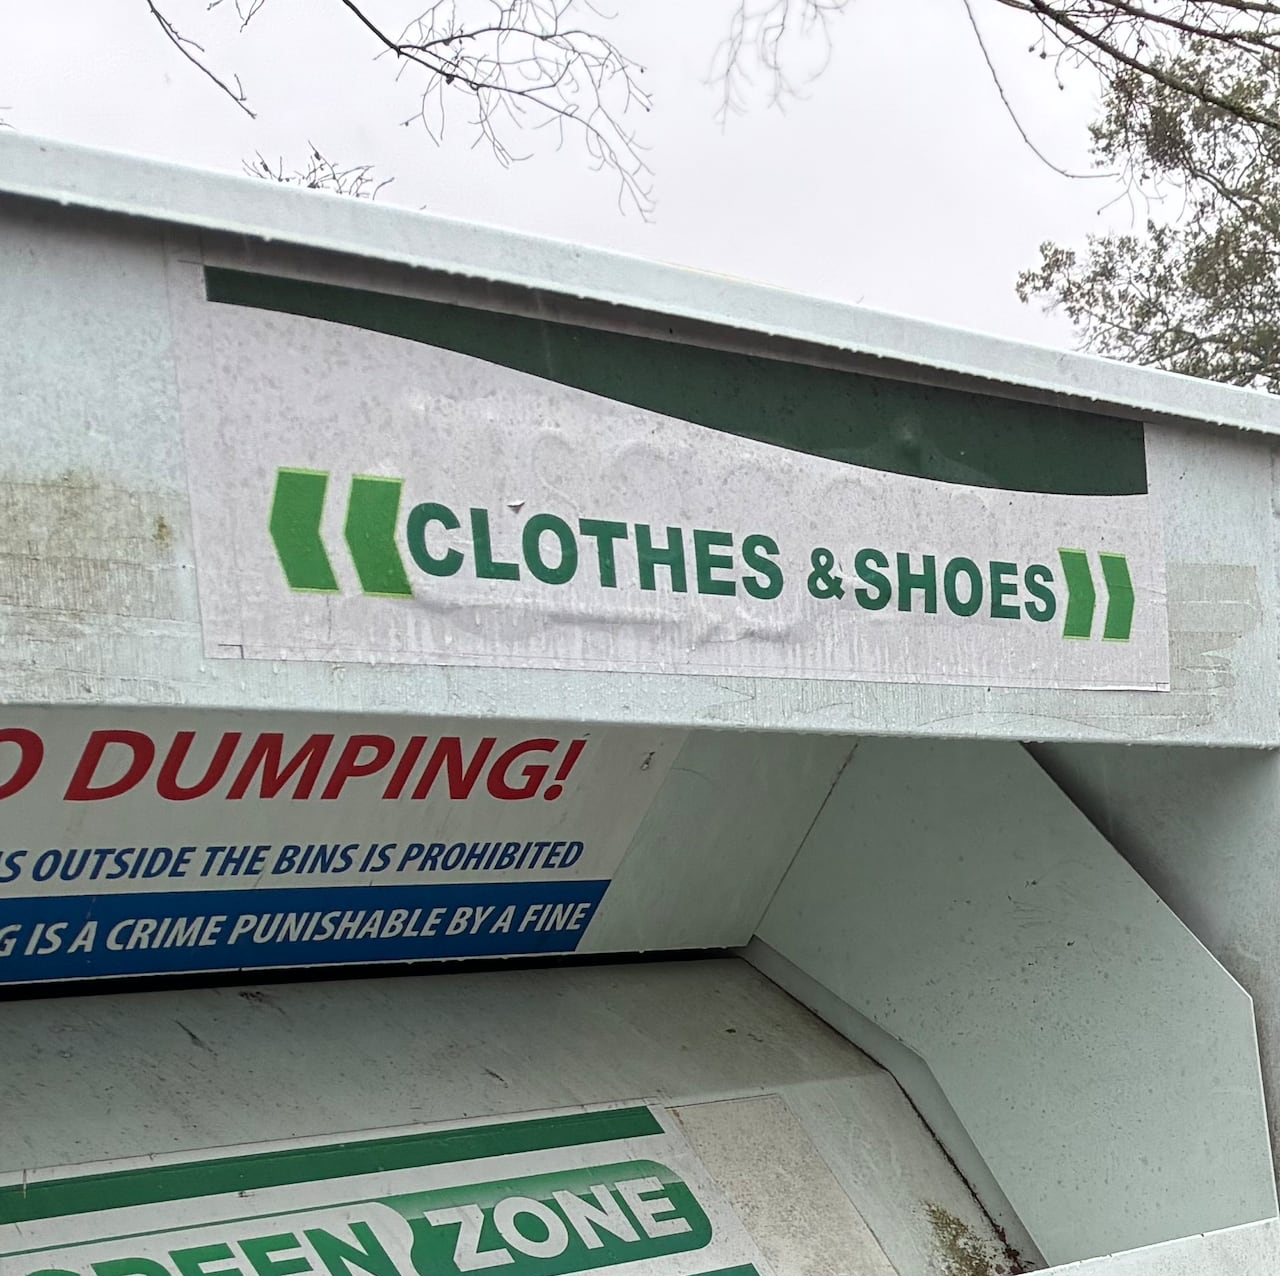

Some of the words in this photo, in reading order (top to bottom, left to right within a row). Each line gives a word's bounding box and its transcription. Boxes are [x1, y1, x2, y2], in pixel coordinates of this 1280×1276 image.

[406, 502, 783, 600] CLOTHES
[63, 729, 587, 801] DUMPING!
[32, 847, 196, 882] OUTSIDE
[201, 844, 266, 876] THE
[272, 843, 358, 874] BINS
[359, 842, 392, 873] IS
[396, 841, 585, 872] PROHIBITED
[24, 922, 69, 955] IS
[67, 921, 98, 953] A
[106, 915, 223, 952] CRIME
[227, 908, 442, 945] PUNISHABLE
[446, 906, 490, 935] BY
[490, 905, 513, 934] A
[518, 903, 591, 932] FINE
[423, 1176, 693, 1272] ZONE
